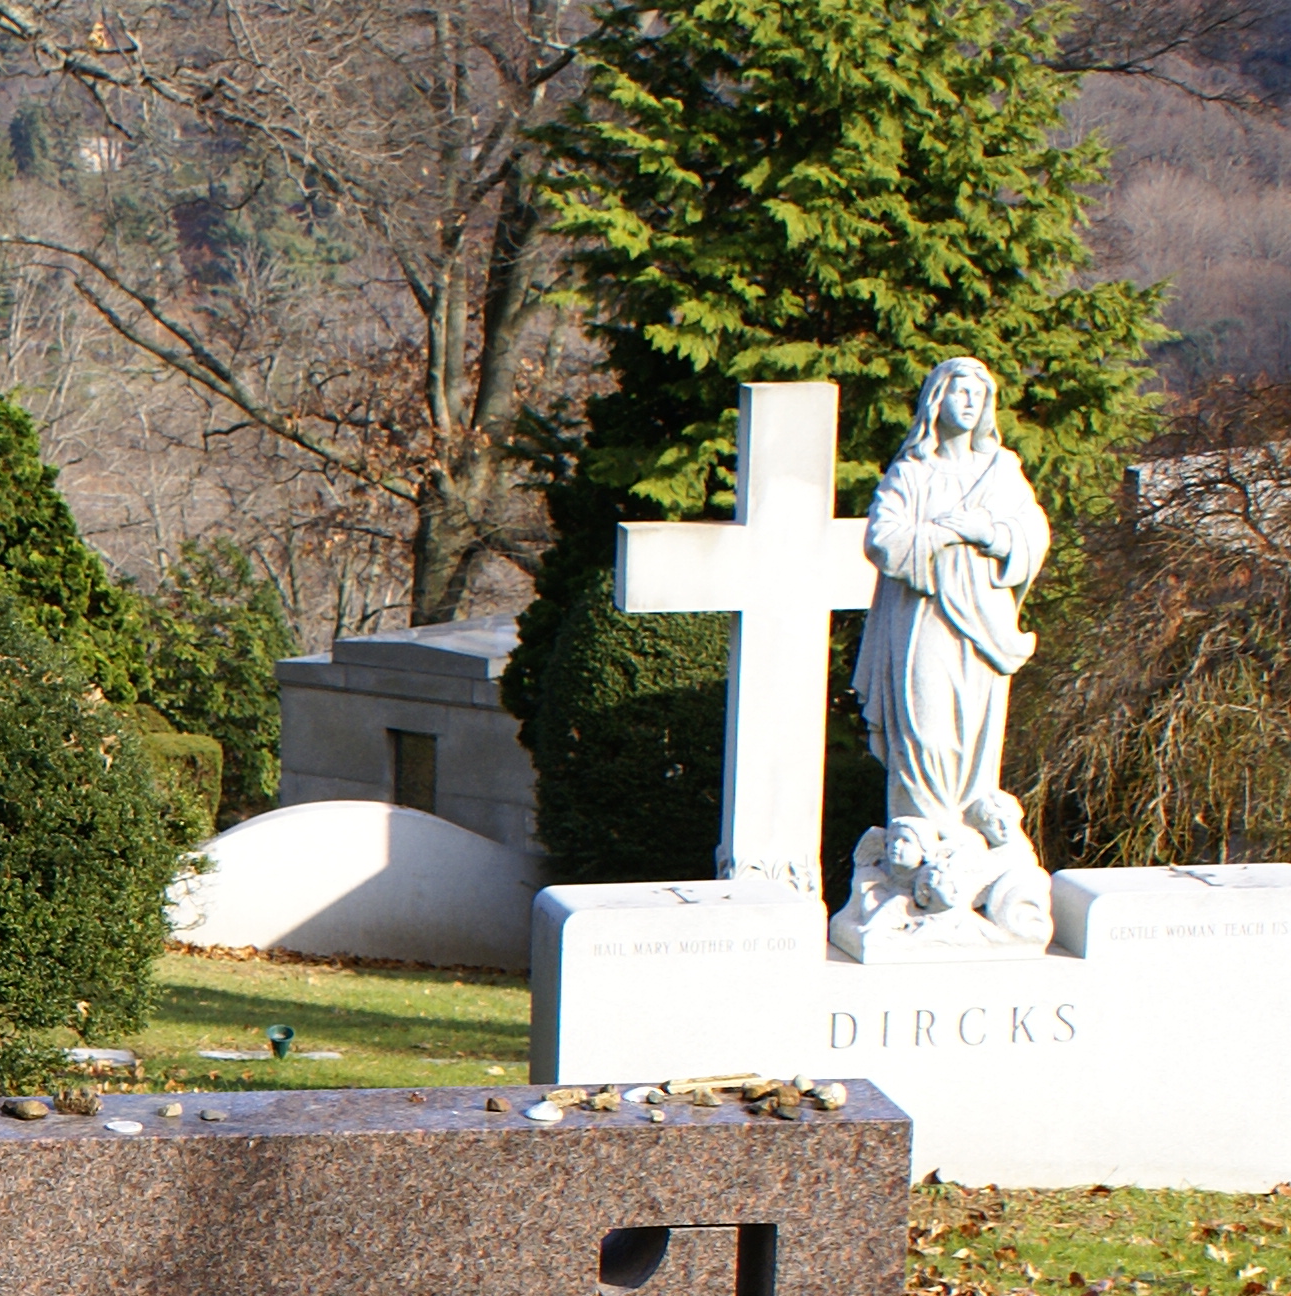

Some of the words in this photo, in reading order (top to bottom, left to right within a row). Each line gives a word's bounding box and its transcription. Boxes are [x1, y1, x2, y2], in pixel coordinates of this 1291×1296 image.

[1110, 926, 1157, 941] GENTLE
[1166, 924, 1216, 938] WOMAN
[1224, 922, 1265, 937] TEACH
[1272, 921, 1288, 936] US
[633, 942, 669, 955] MARY
[679, 939, 734, 954] MOTHER
[742, 938, 759, 951] OF
[767, 937, 797, 951] GOD
[829, 1003, 1077, 1049] DIRCKS
